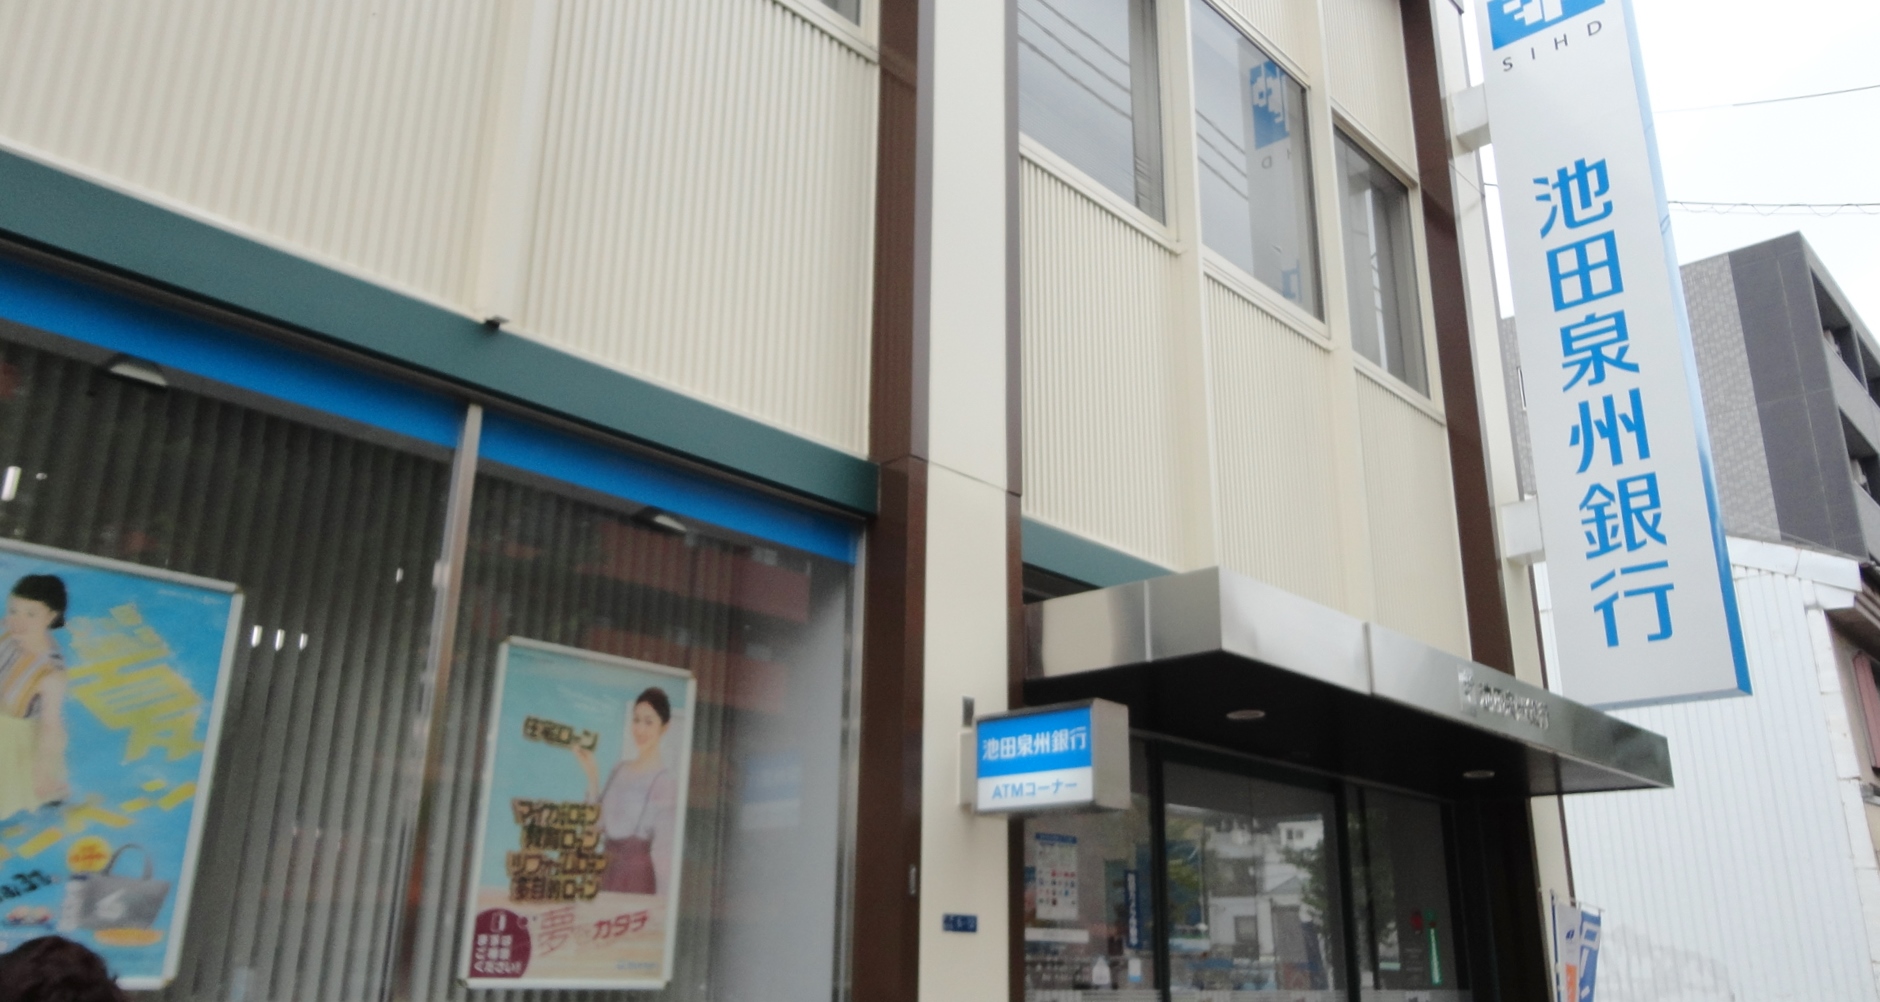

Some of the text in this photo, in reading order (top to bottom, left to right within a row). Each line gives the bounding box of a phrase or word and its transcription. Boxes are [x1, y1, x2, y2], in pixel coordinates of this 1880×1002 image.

[1502, 20, 1602, 72] SIHD
[1533, 157, 1675, 649] 池田泉州銀行
[982, 725, 1088, 762] 池田泉州銀行
[991, 778, 1078, 800] ATMコーナー
